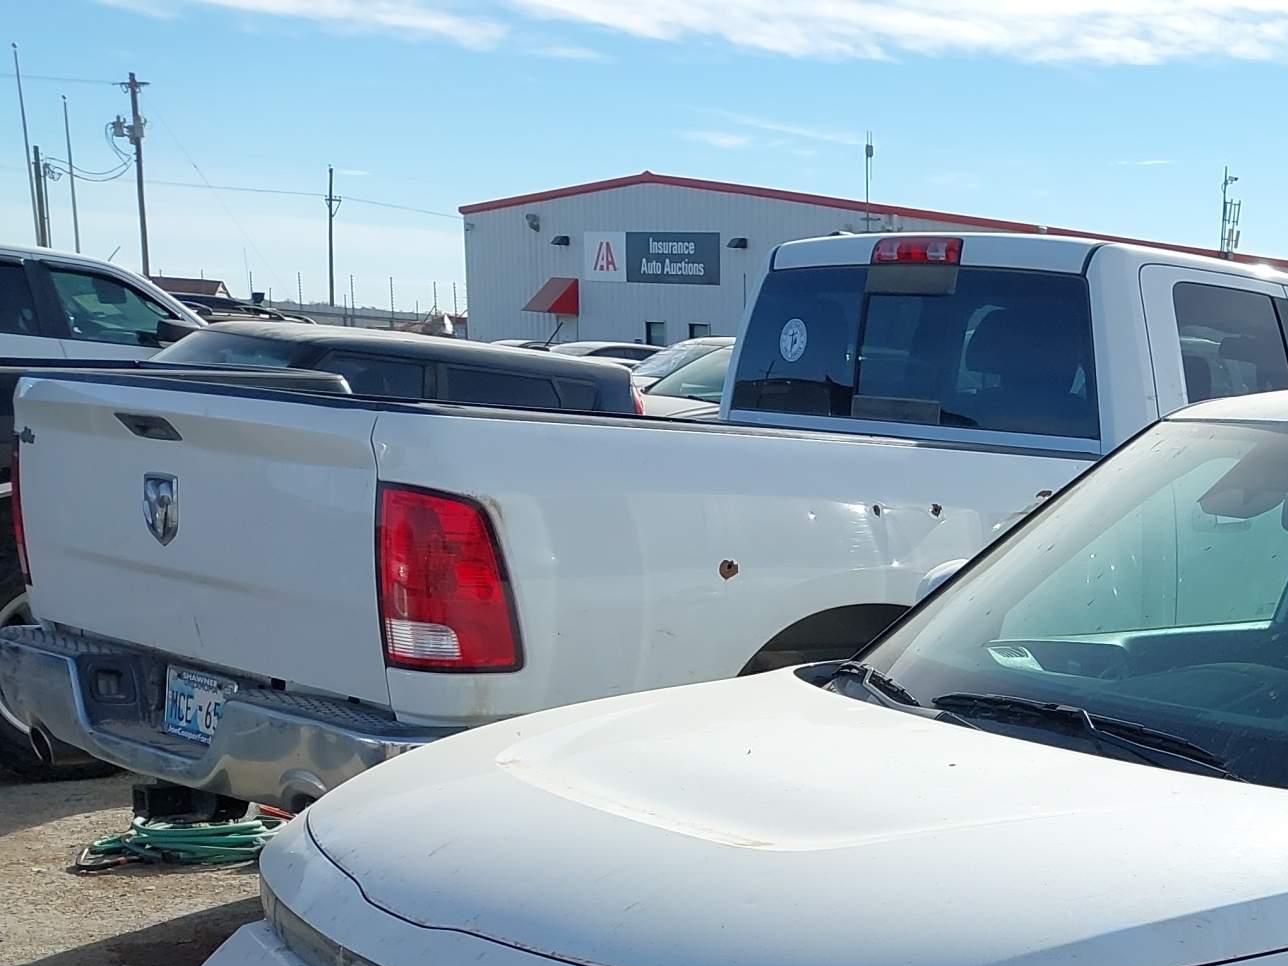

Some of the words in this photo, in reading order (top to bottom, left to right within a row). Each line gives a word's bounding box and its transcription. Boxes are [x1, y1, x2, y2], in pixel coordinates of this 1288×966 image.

[649, 237, 695, 254] Insurance
[640, 258, 662, 274] Auto
[663, 258, 705, 275] Auctions
